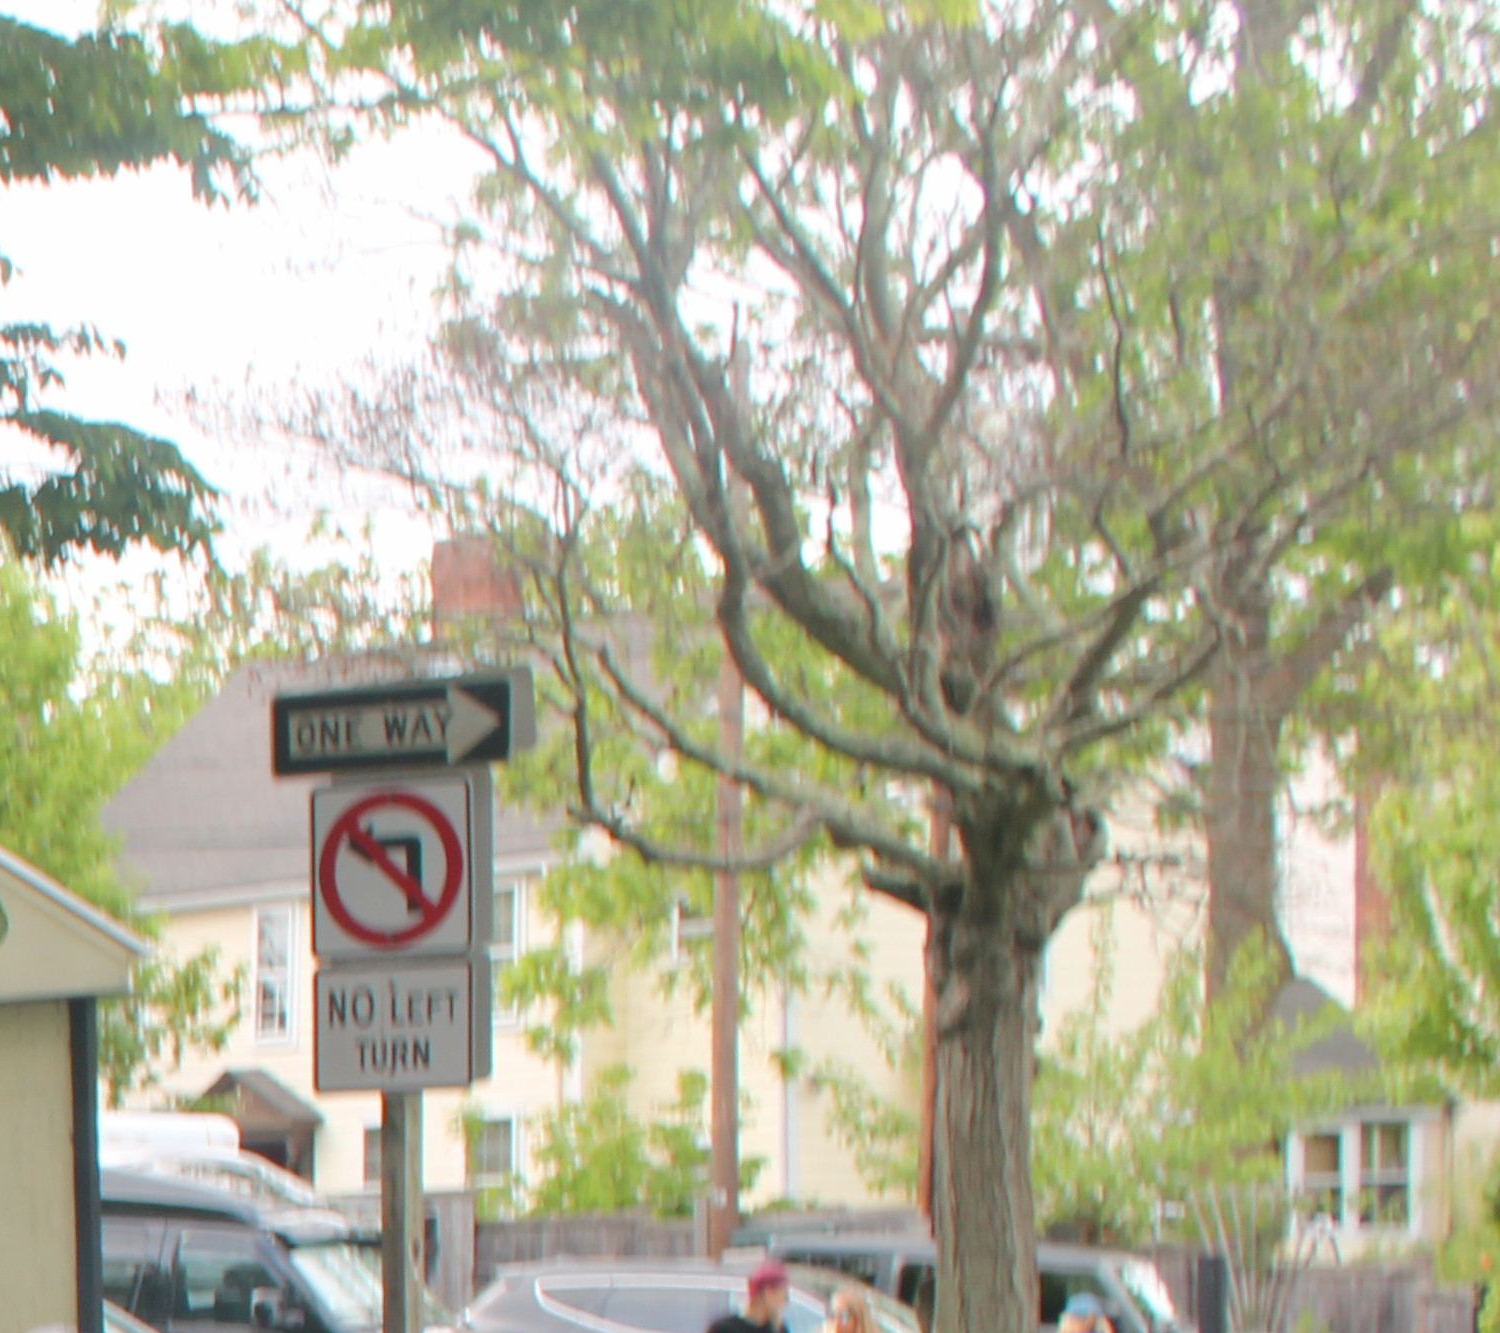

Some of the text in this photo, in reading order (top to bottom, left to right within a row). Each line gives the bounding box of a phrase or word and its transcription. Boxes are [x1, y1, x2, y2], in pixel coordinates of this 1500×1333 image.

[383, 702, 452, 749] WAY
[327, 976, 460, 1031] NO LEFT
[356, 1036, 431, 1078] TURN
